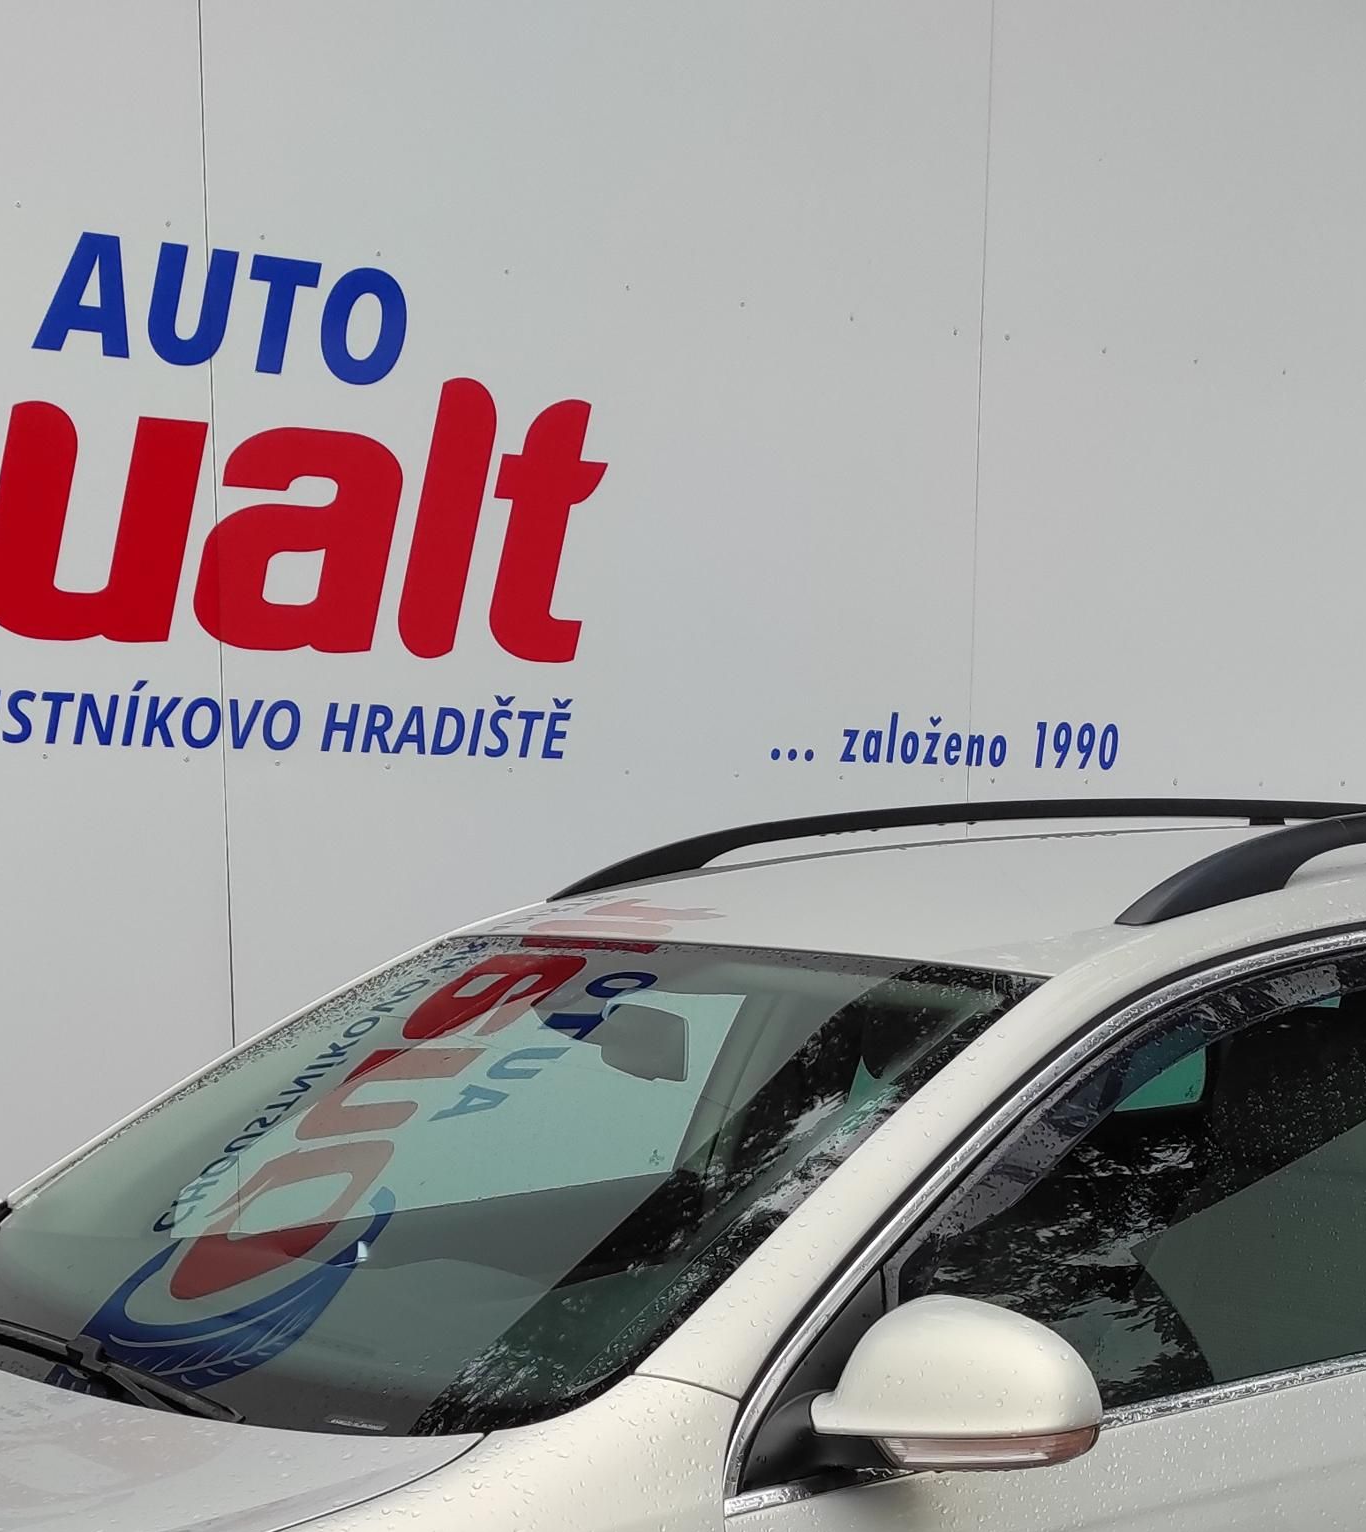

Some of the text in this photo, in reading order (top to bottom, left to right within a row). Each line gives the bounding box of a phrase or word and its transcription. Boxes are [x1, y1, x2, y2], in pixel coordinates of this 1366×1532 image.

[31, 230, 408, 386] AUTO
[320, 695, 573, 761] HRADIŠTĚ
[839, 711, 1008, 768] založeno
[1034, 720, 1120, 771] 1990
